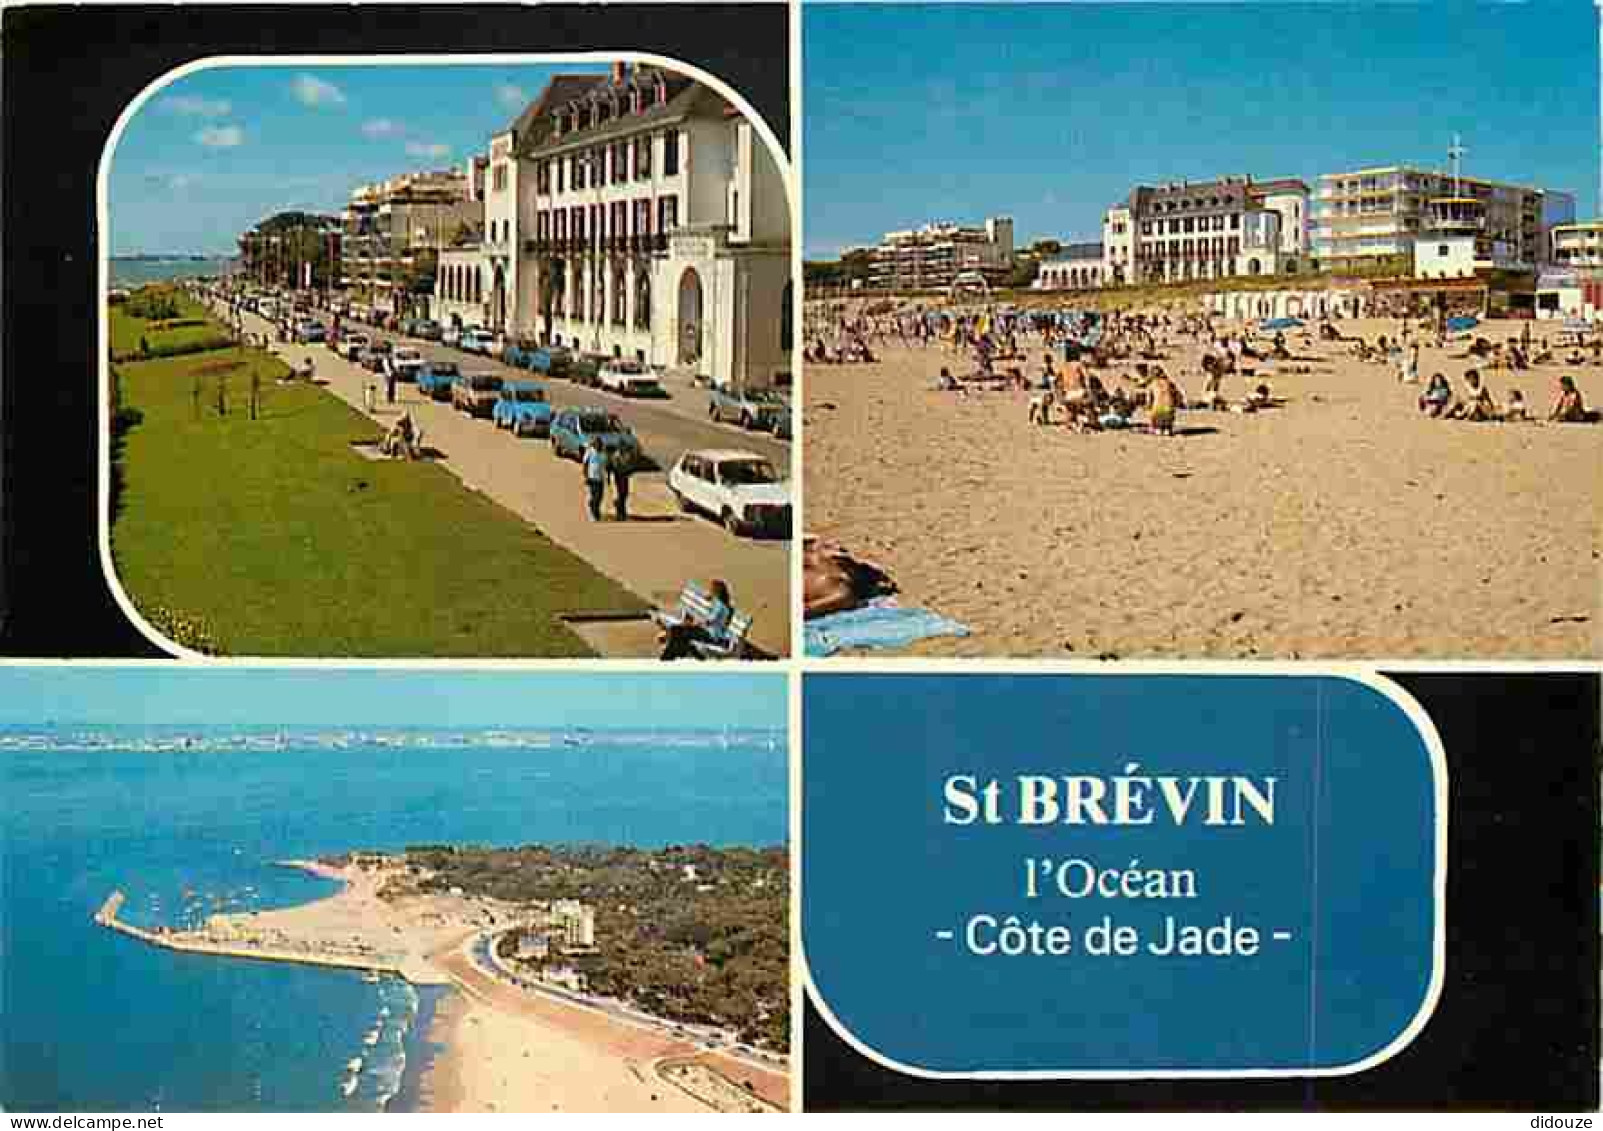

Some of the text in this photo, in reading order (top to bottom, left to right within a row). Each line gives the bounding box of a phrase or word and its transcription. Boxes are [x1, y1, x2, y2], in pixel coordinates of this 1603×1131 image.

[944, 762, 1277, 826] St BRÉVIN
[967, 915, 1071, 956] Côte
[1084, 916, 1139, 956] de
[1148, 916, 1260, 956] Jade
